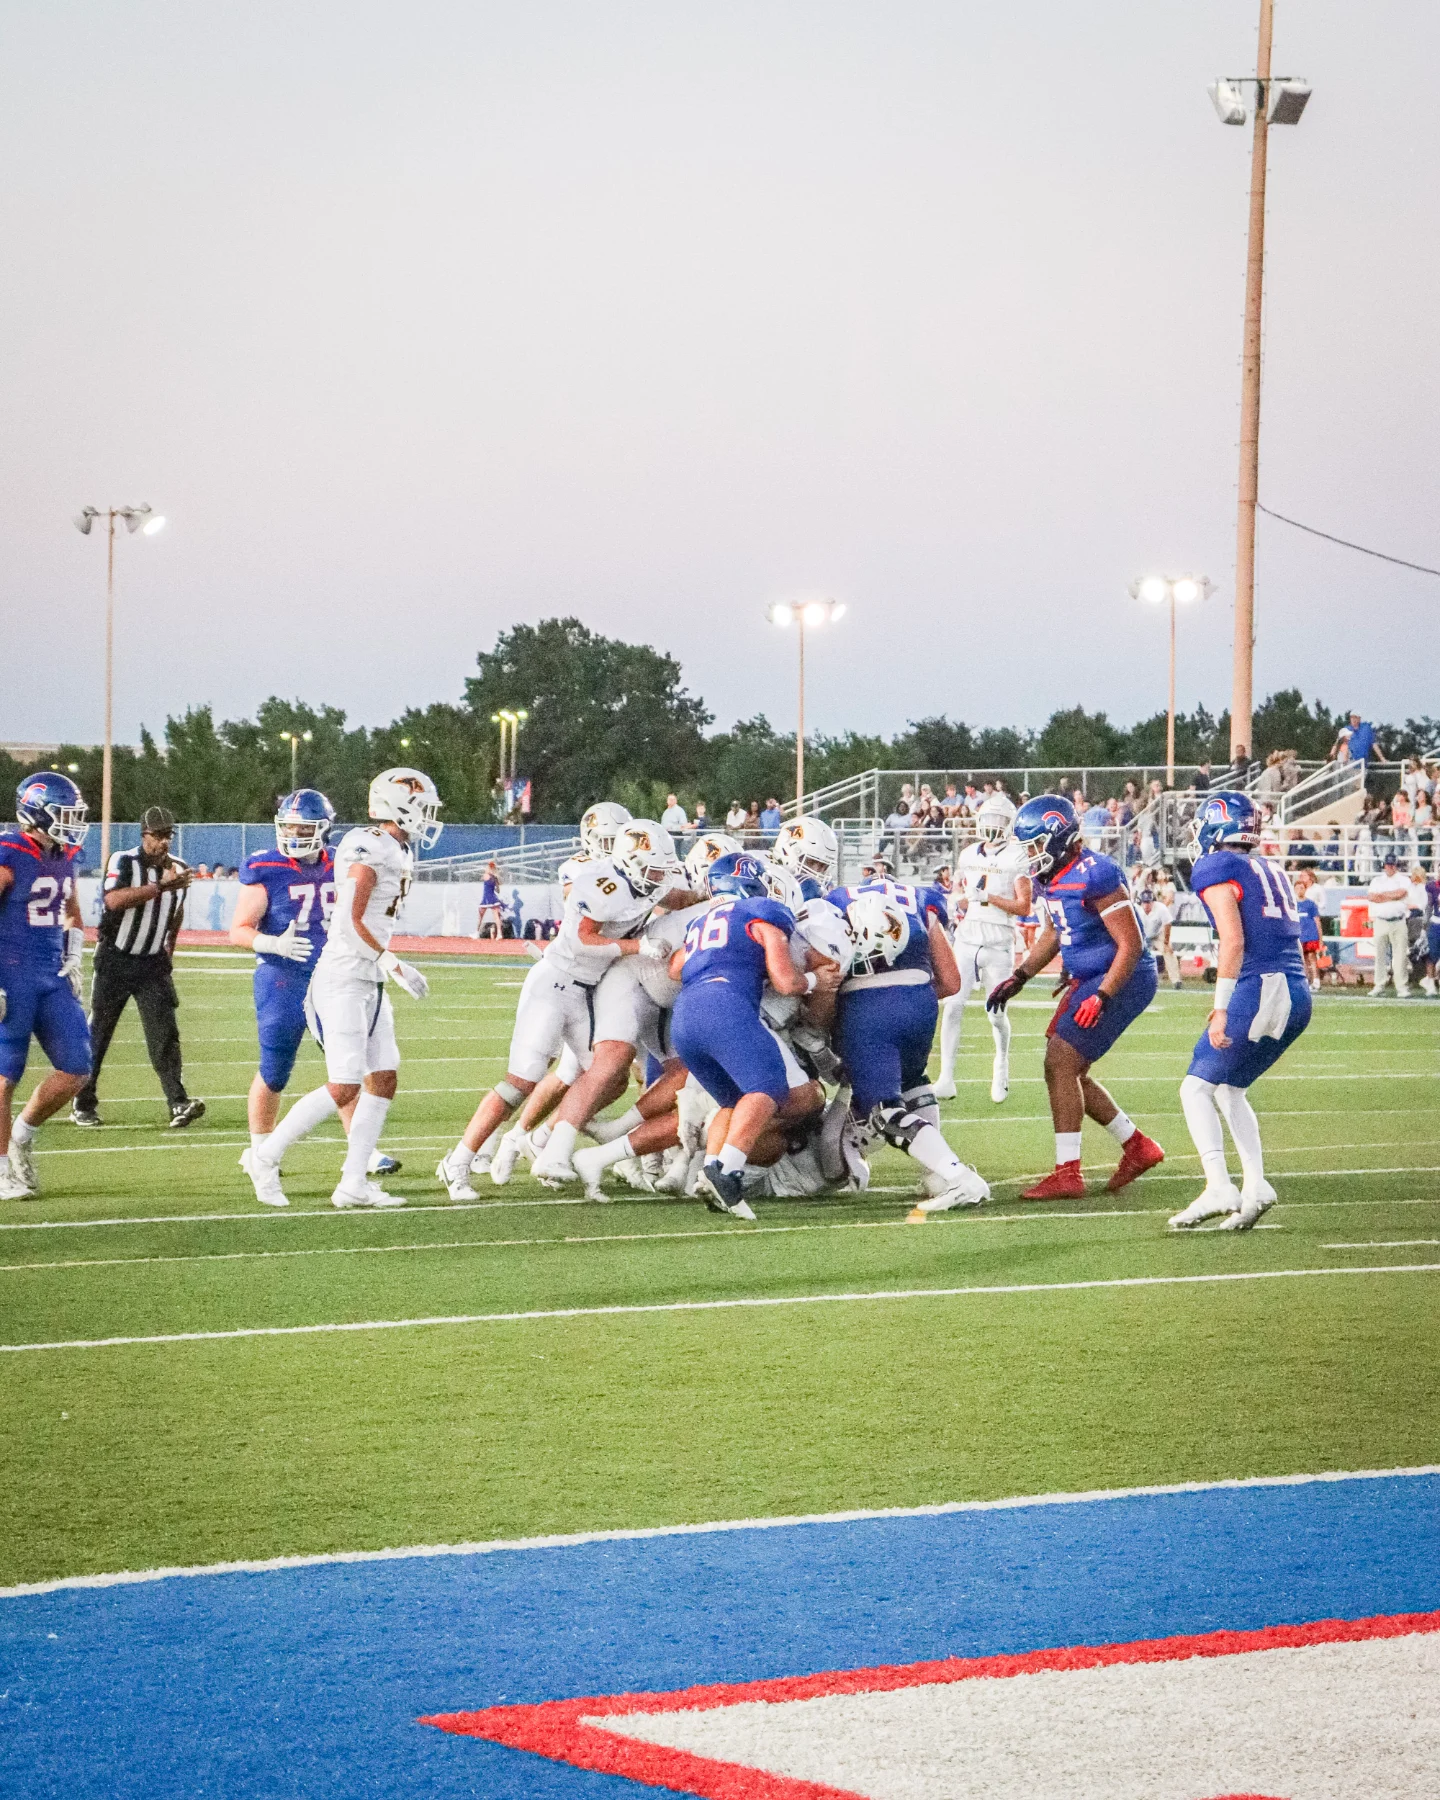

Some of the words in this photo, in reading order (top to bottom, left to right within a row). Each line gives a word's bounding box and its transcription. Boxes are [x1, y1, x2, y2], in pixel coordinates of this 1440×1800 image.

[1076, 856, 1098, 874] 77
[596, 877, 617, 895] 48
[1249, 858, 1300, 922] 10
[685, 902, 735, 962] 56
